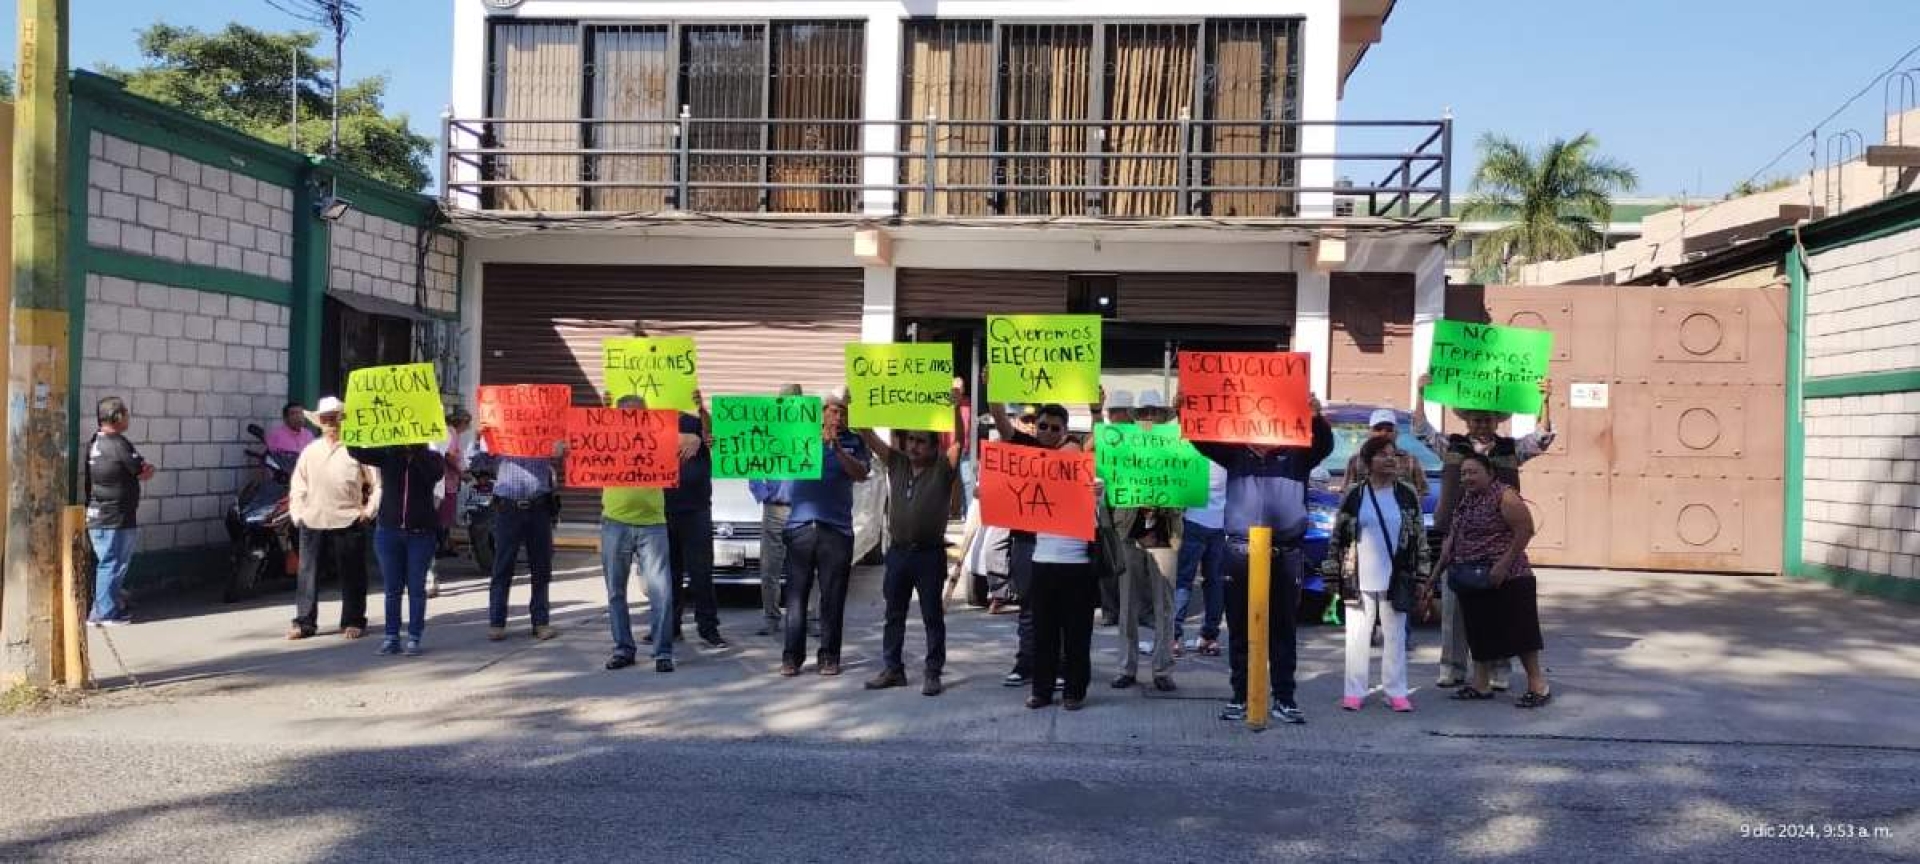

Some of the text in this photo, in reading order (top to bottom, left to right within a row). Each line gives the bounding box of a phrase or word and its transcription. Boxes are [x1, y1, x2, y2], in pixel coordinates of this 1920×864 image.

[1463, 325, 1497, 343] NO
[991, 343, 1097, 365] ELECCIONES
[628, 374, 664, 397] YA
[1223, 377, 1255, 393] AL
[372, 395, 393, 407] AL
[356, 406, 414, 426] EJIDO
[586, 409, 615, 426] NO
[344, 422, 442, 443] DE CUAUTLA
[751, 425, 774, 437] AL
[1184, 416, 1307, 439] DE CUAUTLA
[570, 433, 658, 451] EXCUSAS
[624, 454, 655, 467] LAS
[721, 455, 816, 475] CUAUTLA
[1008, 483, 1056, 518] YA
[1114, 487, 1171, 504] Ejido
